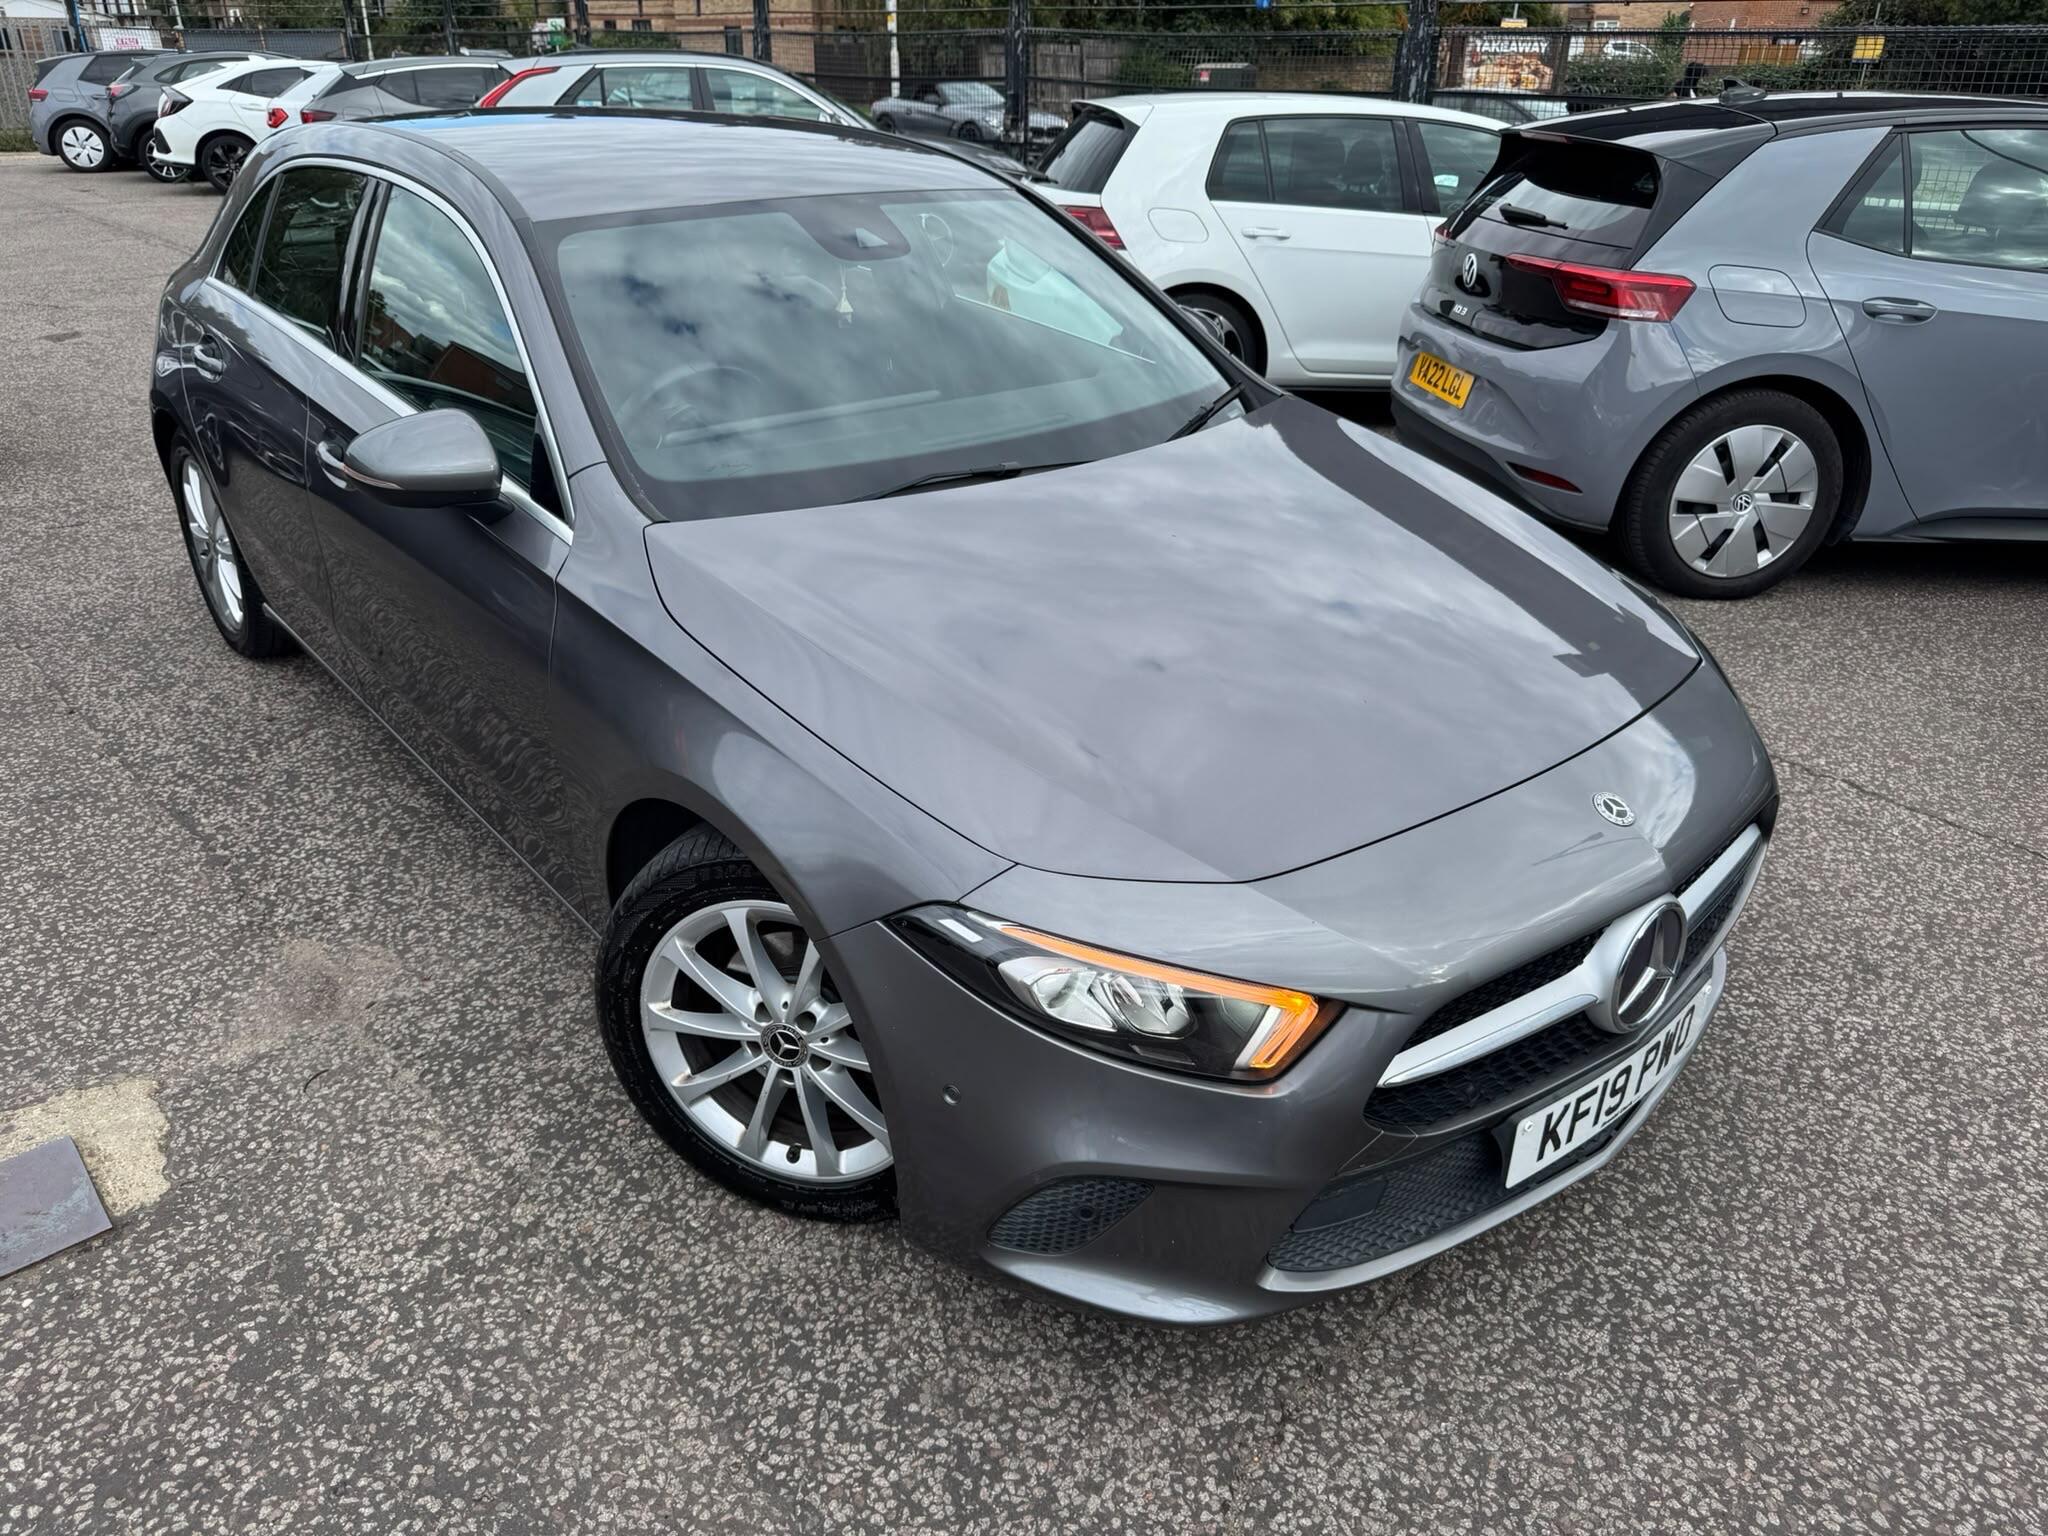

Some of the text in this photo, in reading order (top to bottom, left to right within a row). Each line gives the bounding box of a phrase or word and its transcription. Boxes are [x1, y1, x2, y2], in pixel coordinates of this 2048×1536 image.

[1475, 39, 1549, 53] TAKEAWAY
[1537, 1004, 1696, 1163] KF19 PWO
